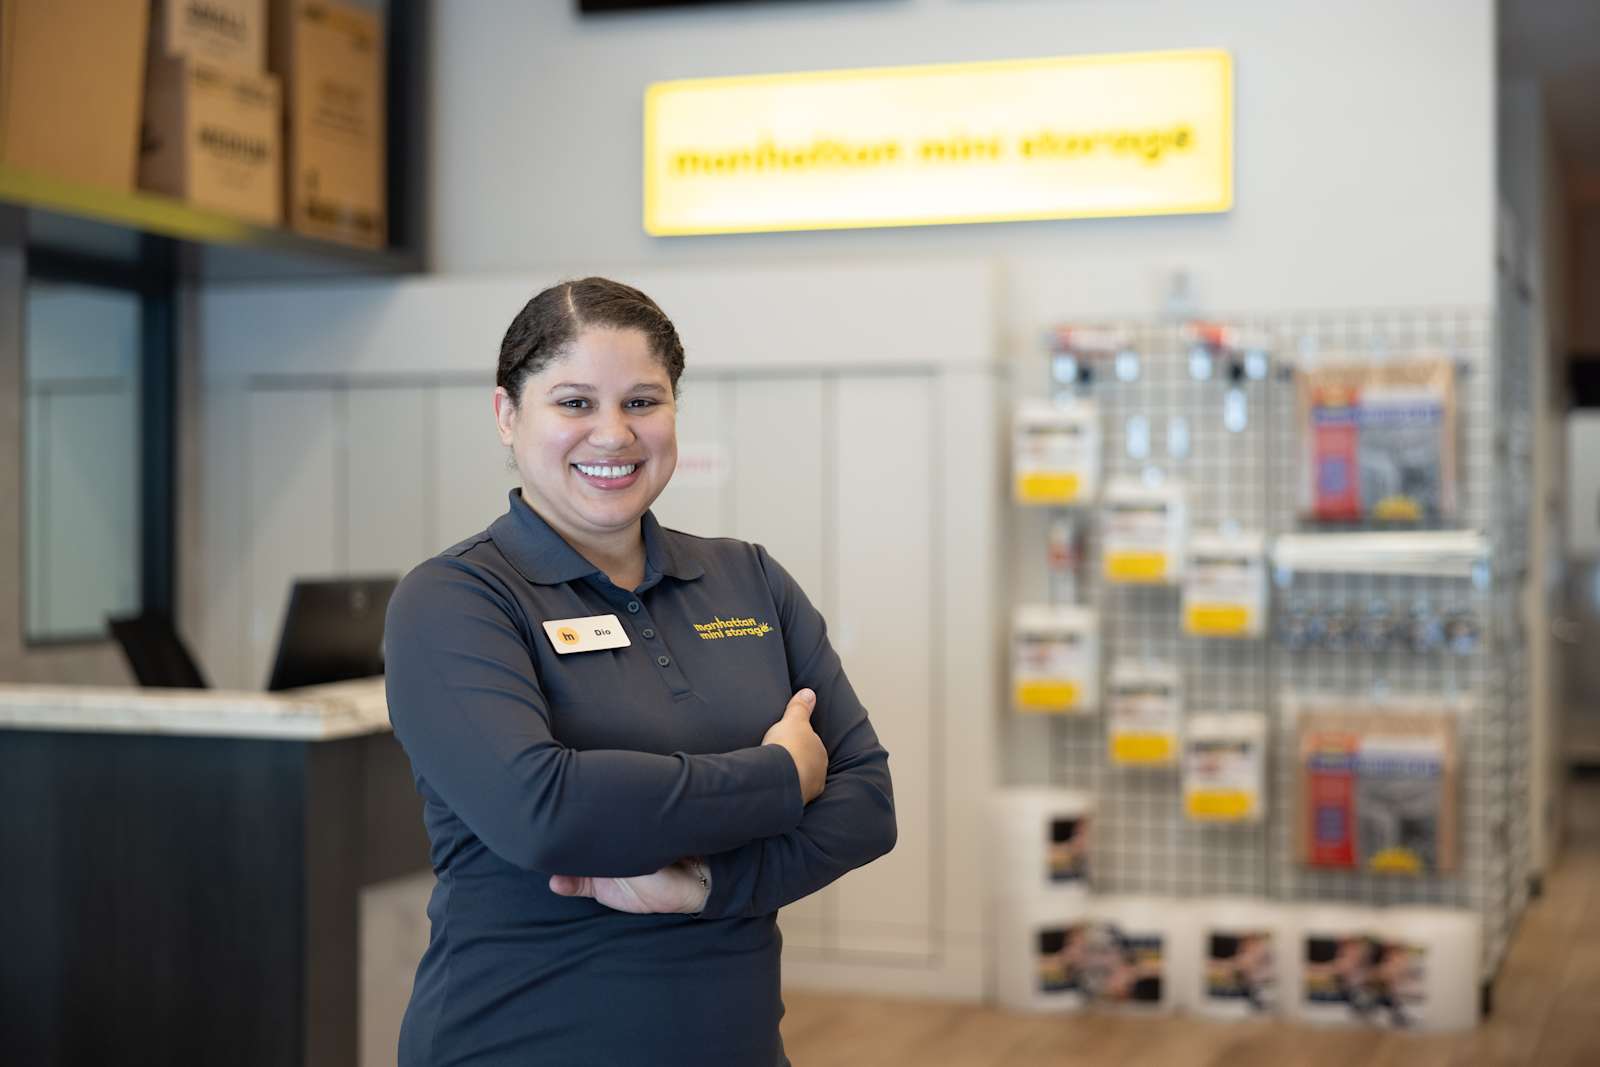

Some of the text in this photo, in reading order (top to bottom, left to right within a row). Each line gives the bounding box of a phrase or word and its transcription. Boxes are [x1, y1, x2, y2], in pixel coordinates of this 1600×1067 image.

[673, 124, 1194, 176] manhattan mini storage
[594, 628, 611, 636] Dio
[693, 616, 757, 632] manhattan
[699, 623, 770, 640] mini storage
